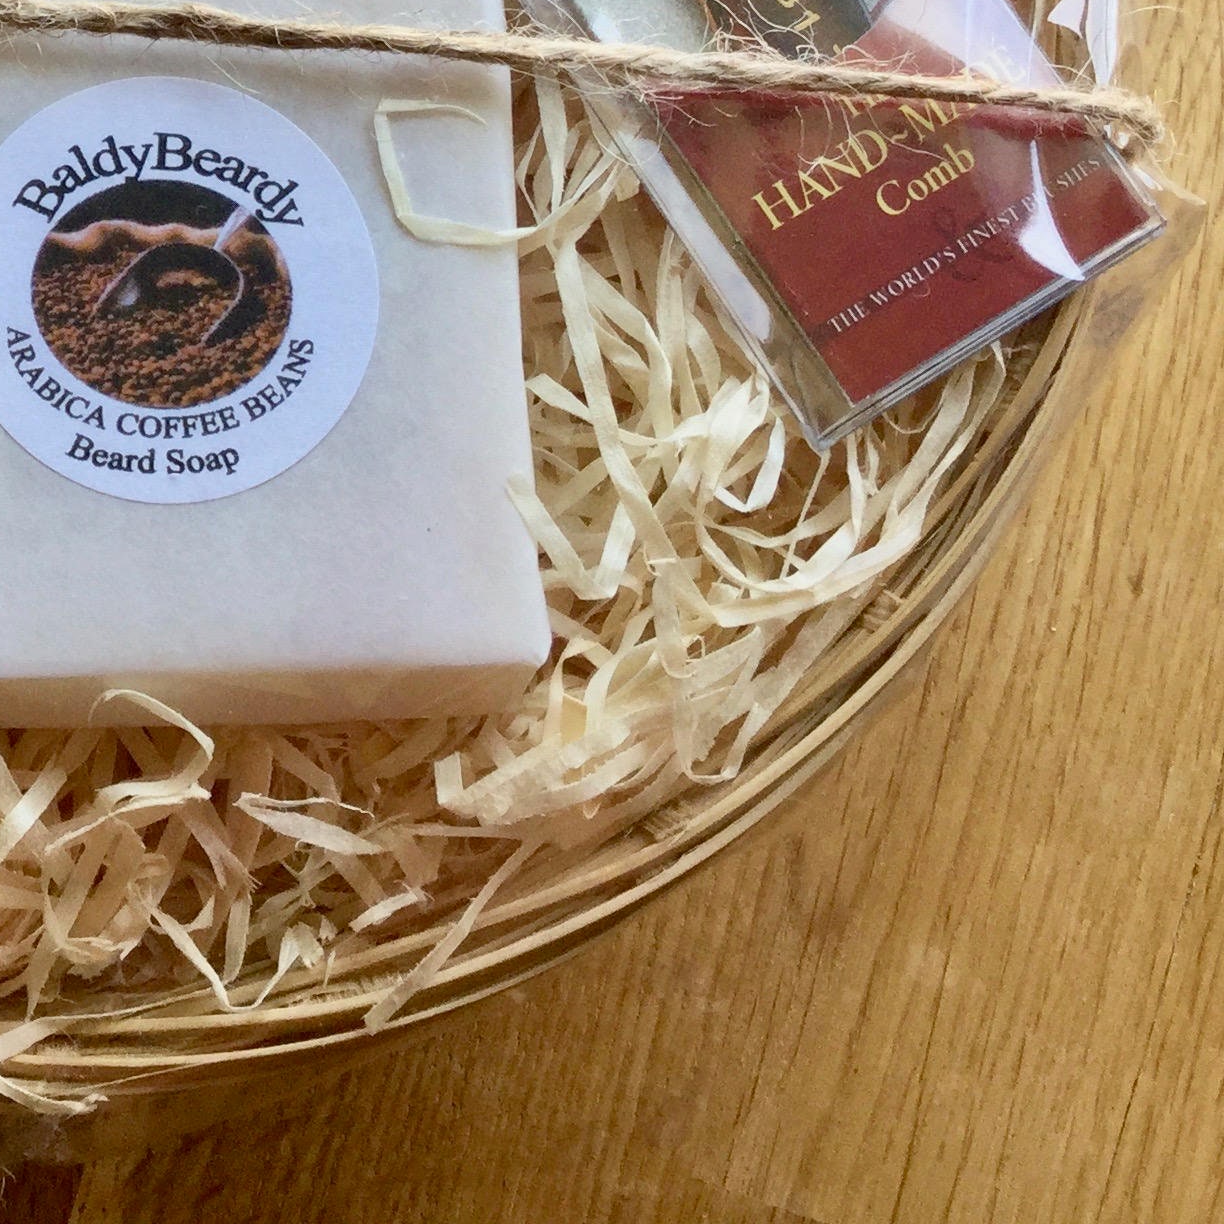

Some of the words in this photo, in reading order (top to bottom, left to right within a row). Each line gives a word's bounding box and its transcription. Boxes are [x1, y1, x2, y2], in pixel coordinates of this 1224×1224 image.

[12, 132, 304, 229] BaldyBeardy
[876, 142, 976, 217] Comb
[827, 301, 869, 333] THE
[869, 246, 957, 307] WORLD'S
[957, 207, 1020, 254] FINEST
[1021, 160, 1100, 214] BSHES
[6, 326, 105, 430] ARABICA
[117, 406, 240, 439] COFFEE
[241, 338, 314, 423] BEANS
[65, 434, 155, 474] Beard
[166, 447, 240, 476] Soap
